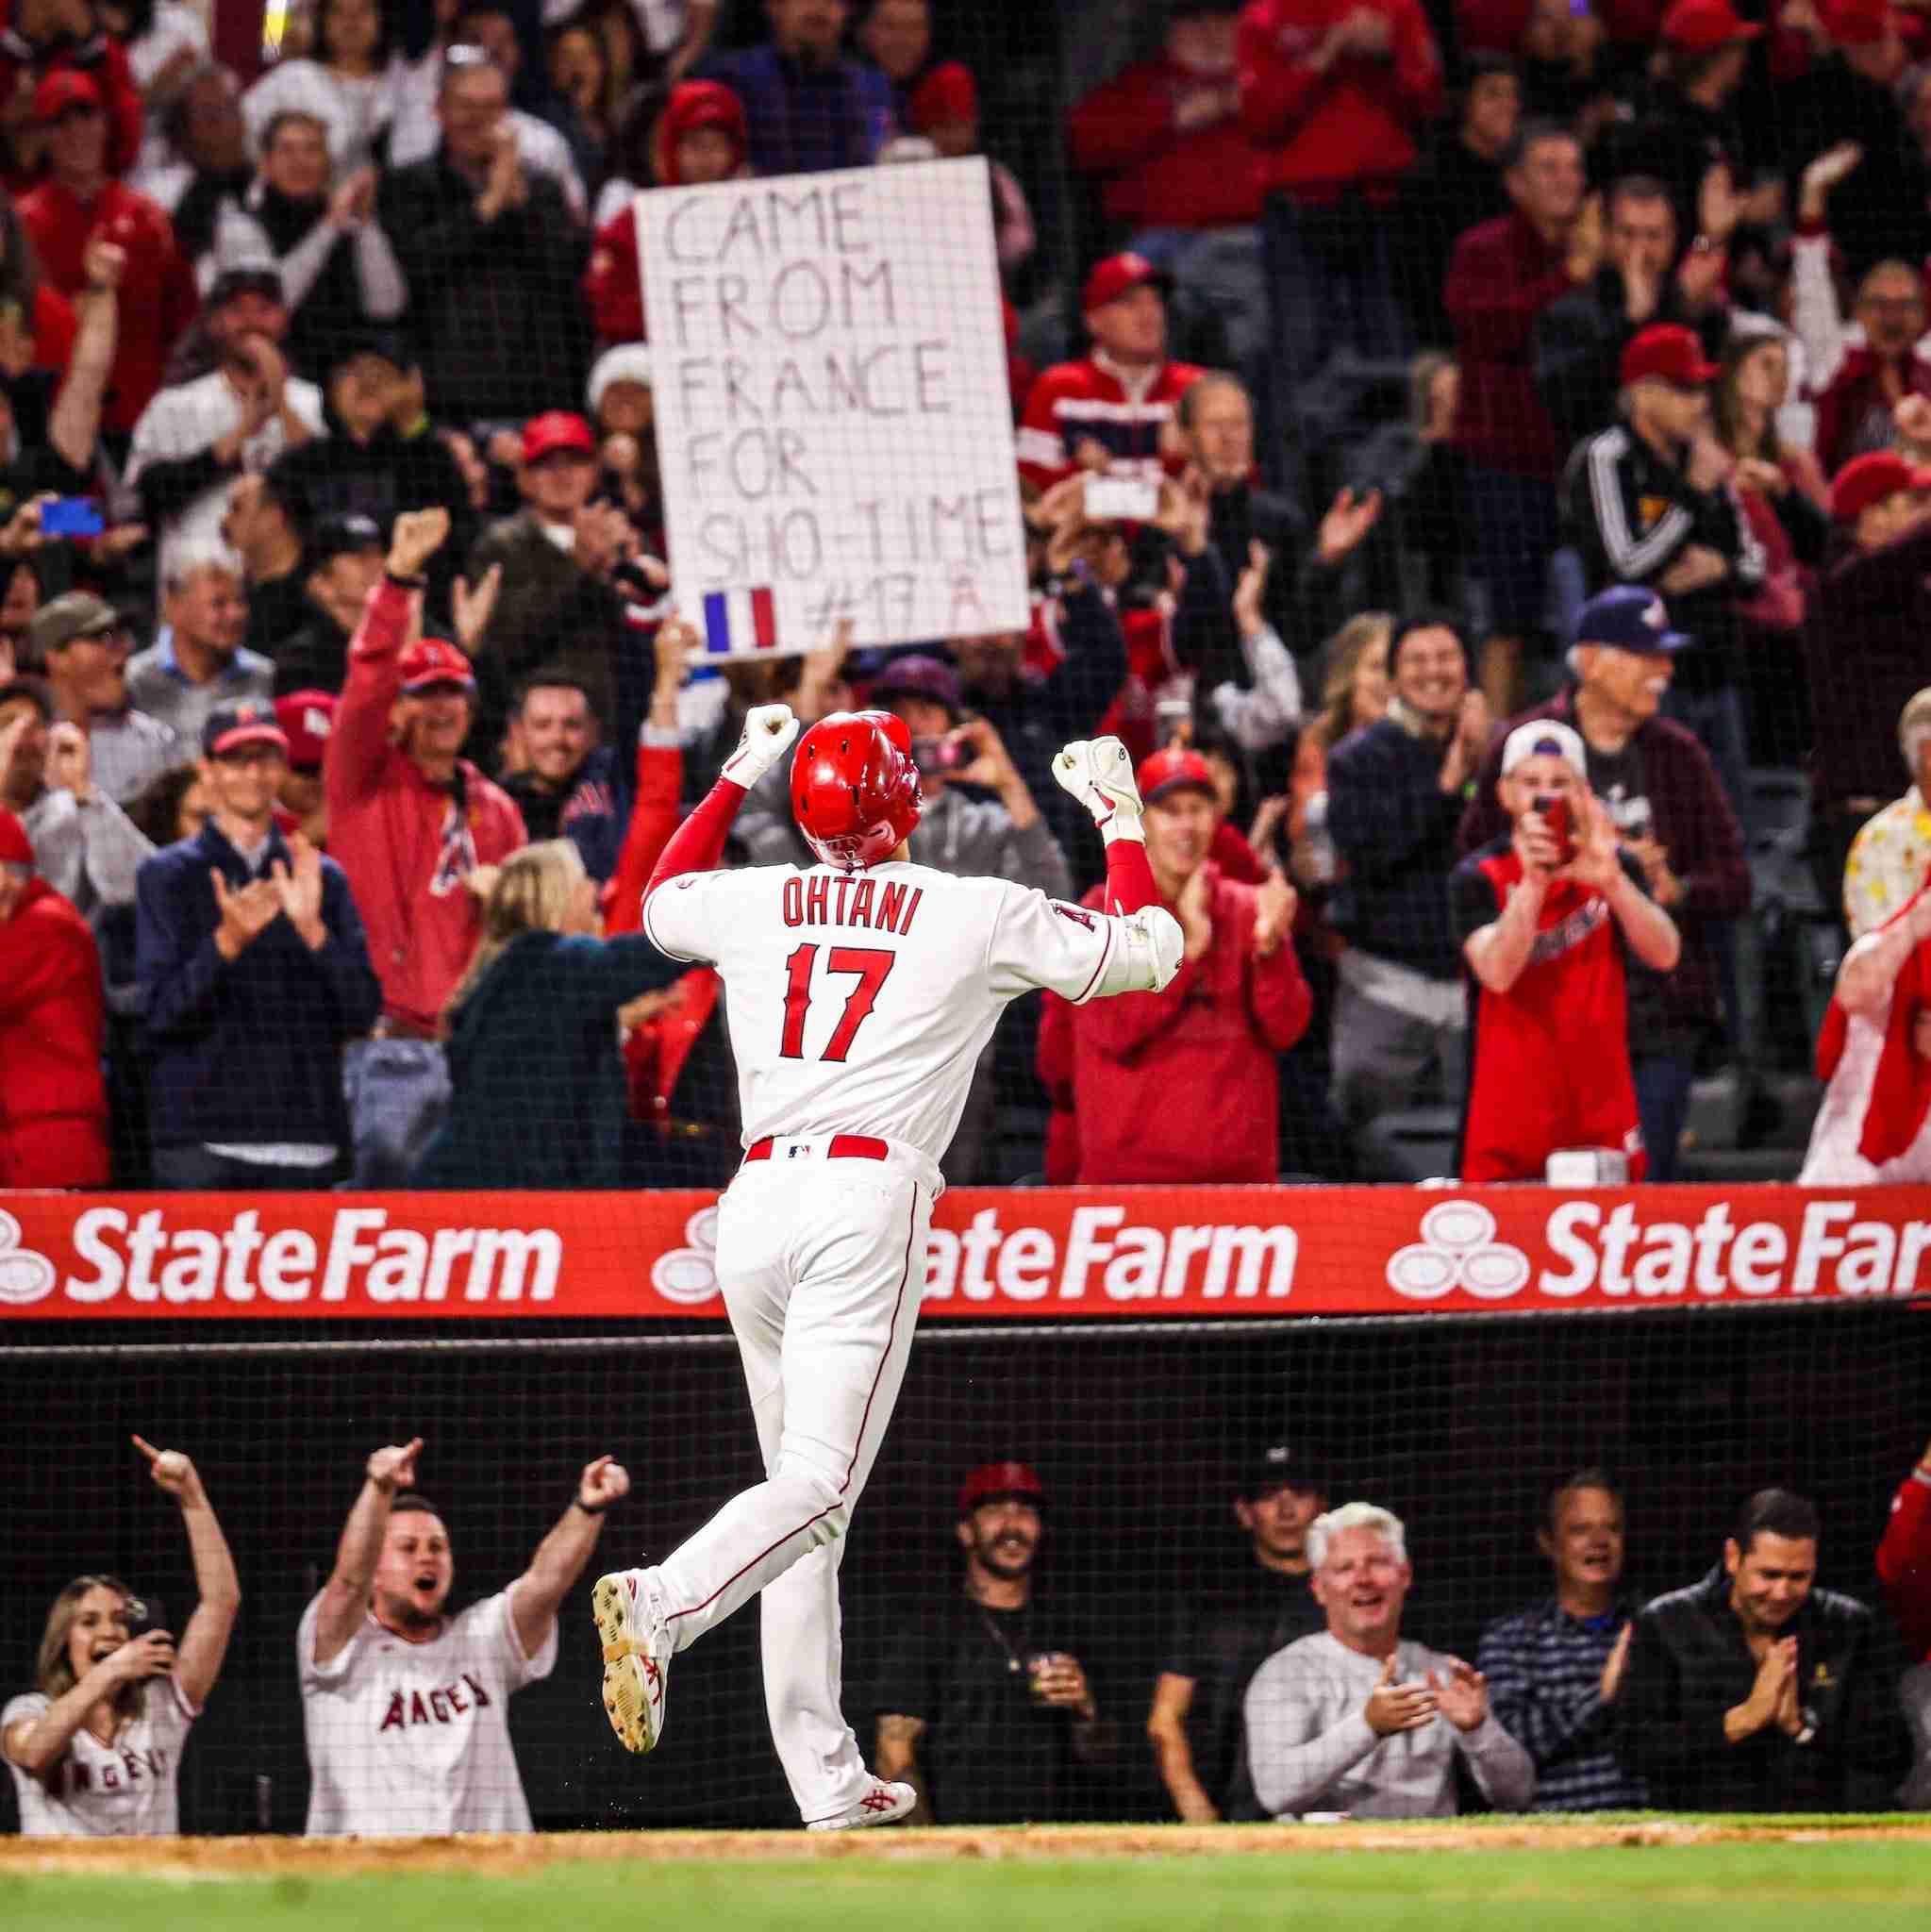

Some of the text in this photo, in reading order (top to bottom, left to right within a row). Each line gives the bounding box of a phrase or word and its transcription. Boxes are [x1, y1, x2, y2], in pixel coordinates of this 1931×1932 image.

[664, 182, 869, 266] CAME
[672, 258, 898, 349] FROM
[678, 341, 952, 430] FRANCE
[686, 427, 819, 502] FOR
[698, 487, 1014, 584] SHO-TIME
[803, 571, 918, 633] #17
[782, 874, 924, 937] OHTANI
[779, 942, 897, 1063] 17
